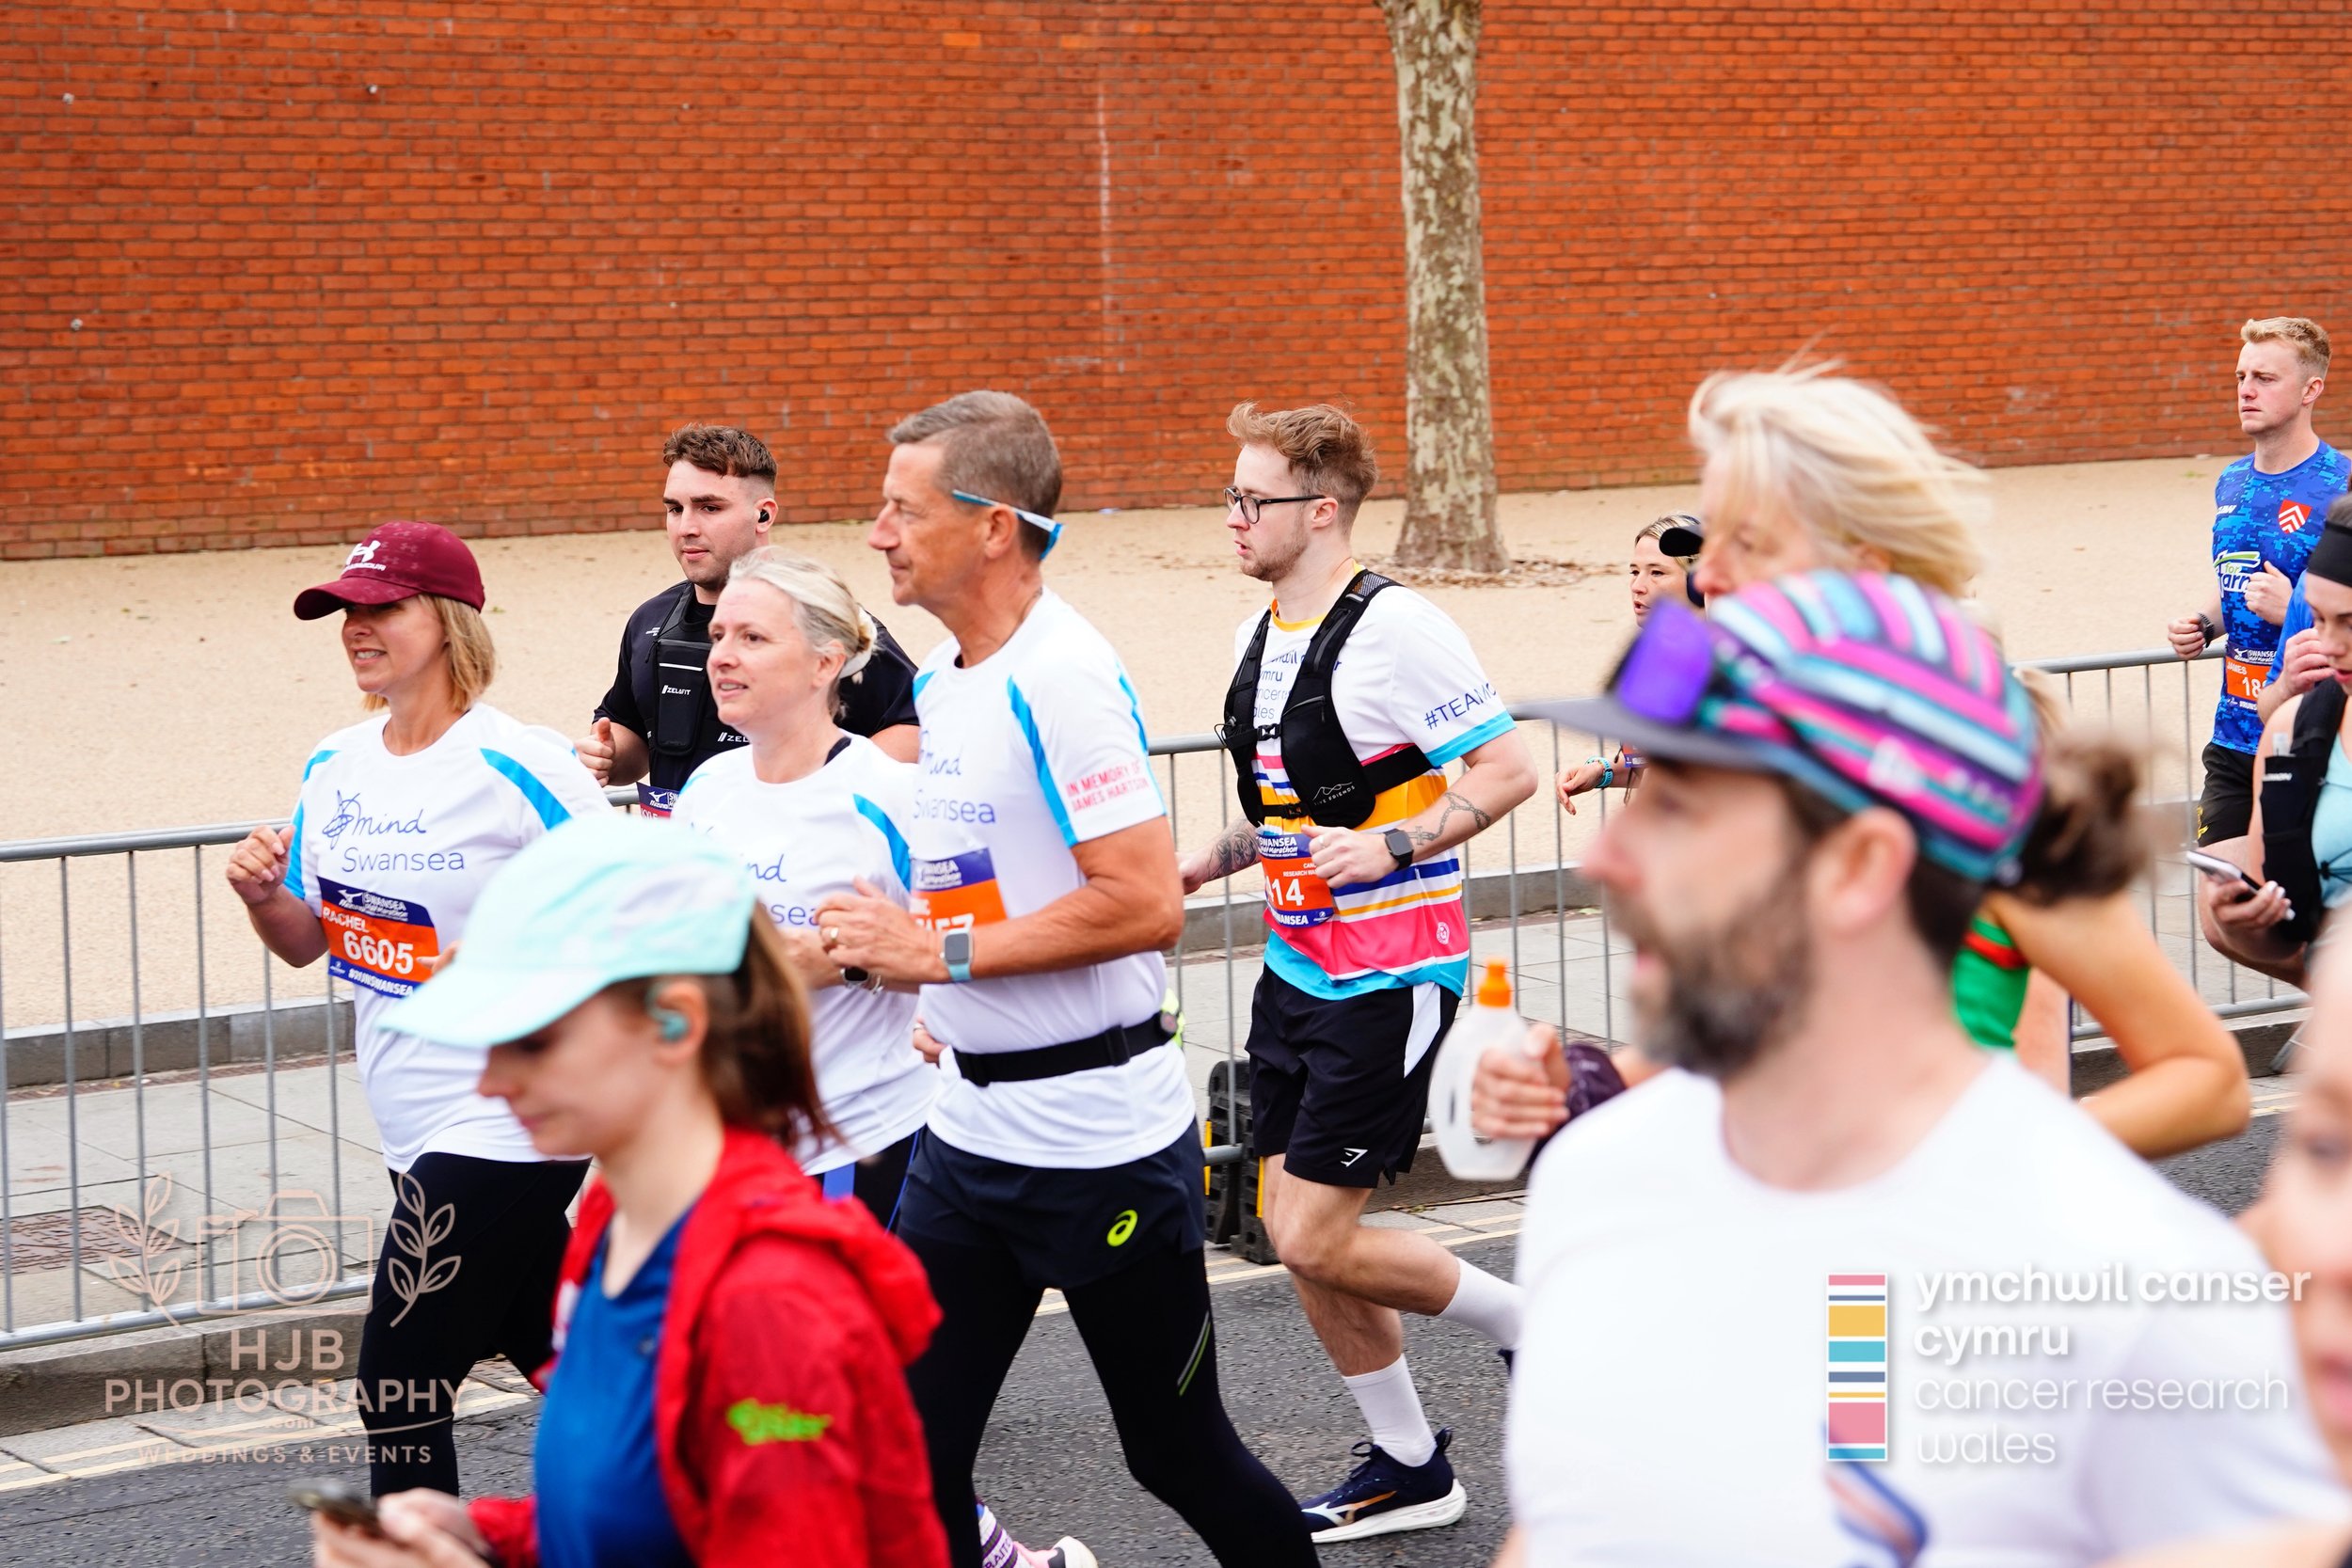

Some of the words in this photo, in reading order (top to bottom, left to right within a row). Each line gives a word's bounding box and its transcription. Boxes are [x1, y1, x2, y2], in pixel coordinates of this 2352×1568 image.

[2225, 562, 2240, 574] for
[667, 688, 691, 696] ZELAFIT
[1257, 688, 1282, 701] ncer
[2242, 676, 2266, 698] 18
[342, 847, 465, 873] Swansea
[748, 853, 787, 882] nd
[323, 906, 369, 933] RACHEL
[342, 930, 414, 974] 6605
